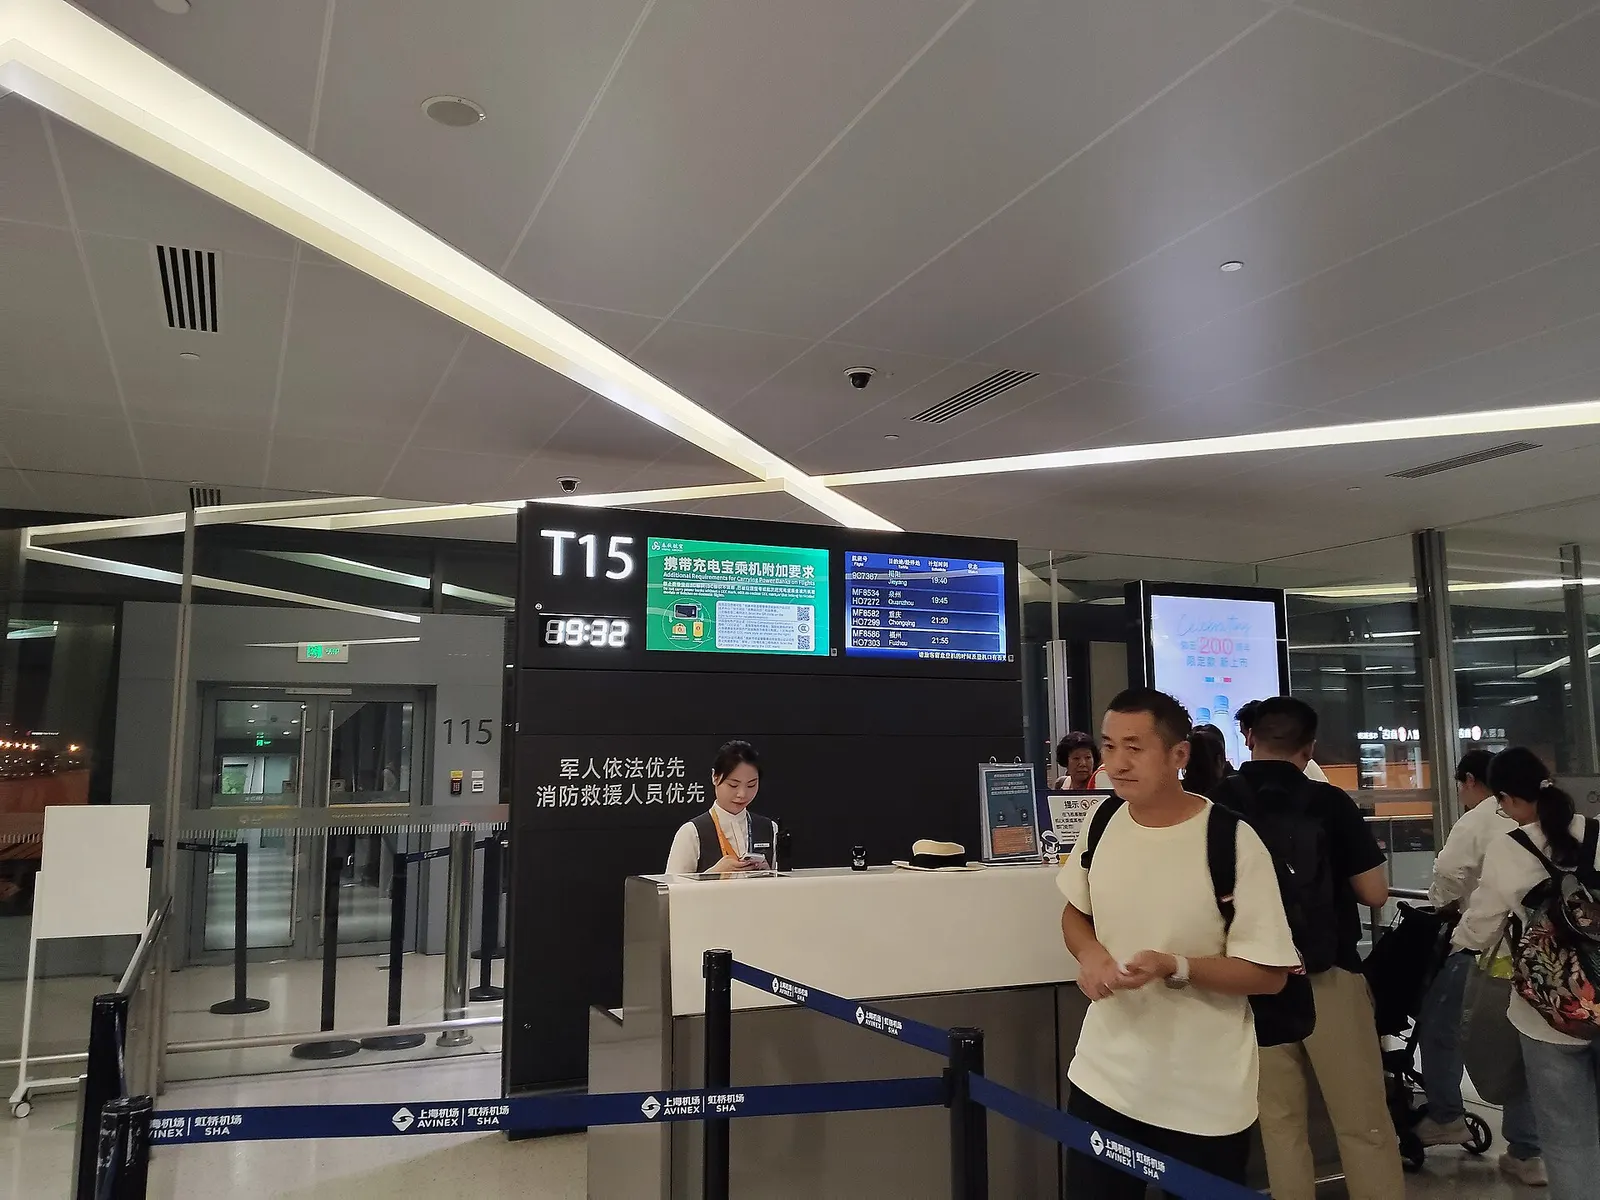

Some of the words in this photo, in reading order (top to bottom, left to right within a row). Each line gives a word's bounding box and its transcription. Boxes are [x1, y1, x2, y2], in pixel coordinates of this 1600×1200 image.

[540, 529, 634, 580] T15
[663, 556, 815, 579] 携带充电宝乘机附加要求
[692, 573, 728, 581] Requirements
[931, 576, 948, 584] 19:40
[852, 588, 880, 597] MF8534
[852, 597, 880, 606] HO7272
[888, 598, 915, 606] Quanzhou
[931, 596, 948, 604] 19:45
[852, 608, 880, 617] MF8582
[852, 618, 880, 626] HO7299
[888, 618, 916, 628] Chongqing
[931, 616, 949, 624] 21:20
[544, 618, 630, 648] 19:32
[852, 629, 880, 638] MF8586
[852, 638, 881, 647] HO7303
[888, 639, 909, 647] Fuzhou
[931, 636, 949, 645] 21:55
[1199, 636, 1235, 655] 200
[443, 718, 493, 745] 115
[559, 756, 686, 780] 军人依法优先
[536, 782, 705, 808] 消防救援人员优先
[1064, 800, 1079, 809] 提示
[887, 1026, 899, 1036] SHA
[664, 1095, 701, 1108] 上海机场
[707, 1093, 745, 1105] 虹桥机场
[417, 1107, 459, 1120] 上海机场
[467, 1105, 510, 1117] 虹桥机场
[663, 1105, 700, 1116] AVINEX
[716, 1104, 737, 1113] SHA
[194, 1114, 243, 1127] 虹桥机场
[417, 1118, 459, 1128] AVINEX
[476, 1116, 500, 1125] SHA
[204, 1126, 230, 1136] SHA
[1105, 1138, 1132, 1158] 上海机场
[1136, 1151, 1166, 1173] 虹桥机场
[1105, 1149, 1132, 1168] AVINEX
[1143, 1165, 1160, 1180] SHA
